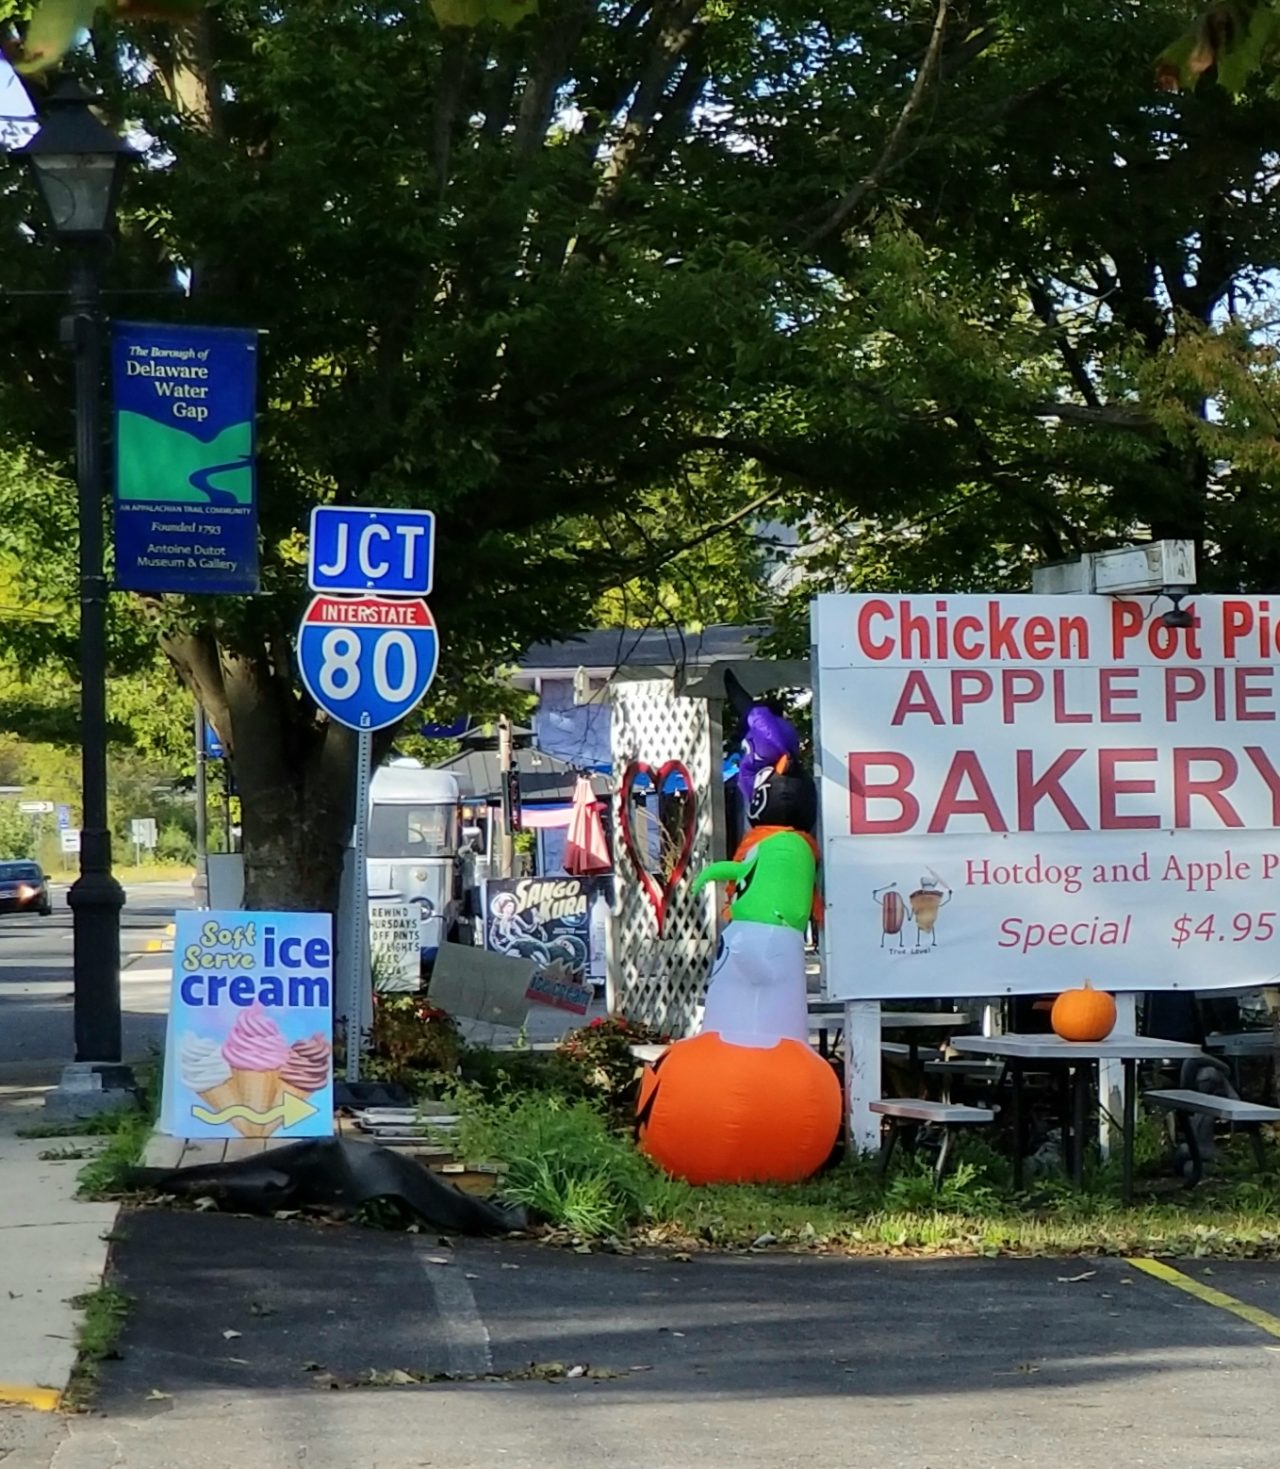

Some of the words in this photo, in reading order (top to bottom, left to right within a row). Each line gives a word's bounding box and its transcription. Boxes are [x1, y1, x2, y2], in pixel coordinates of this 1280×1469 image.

[129, 346, 149, 357] The
[151, 347, 196, 360] Borough
[197, 348, 211, 361] of
[127, 360, 208, 379] Delaware
[154, 381, 208, 399] Water
[173, 402, 208, 422] Gap
[205, 507, 251, 515] COMMUNITY
[151, 522, 196, 533] Founded
[198, 525, 221, 535] 1793
[137, 557, 185, 568] Museum
[187, 558, 197, 568] &
[200, 559, 237, 572] Gallery
[147, 544, 192, 555] Antoine
[194, 545, 226, 556] Dutot
[318, 523, 425, 579] JCT
[322, 604, 416, 624] INTERSTATE
[856, 599, 1090, 661] Chicken
[1110, 600, 1203, 661] Pot
[319, 628, 417, 703] 80
[890, 667, 1143, 726] APPLE
[1164, 666, 1276, 722] PIE
[965, 854, 1083, 894] Hotdog
[1092, 852, 1151, 883] and
[1161, 850, 1251, 892] Apple
[516, 879, 581, 914] SANGO
[539, 895, 587, 925] KURA
[200, 920, 256, 950] Soft
[264, 927, 330, 968] ice
[997, 914, 1132, 954] Special
[1170, 912, 1277, 949] $4.95
[183, 944, 255, 971] Serve
[180, 975, 329, 1007] cream
